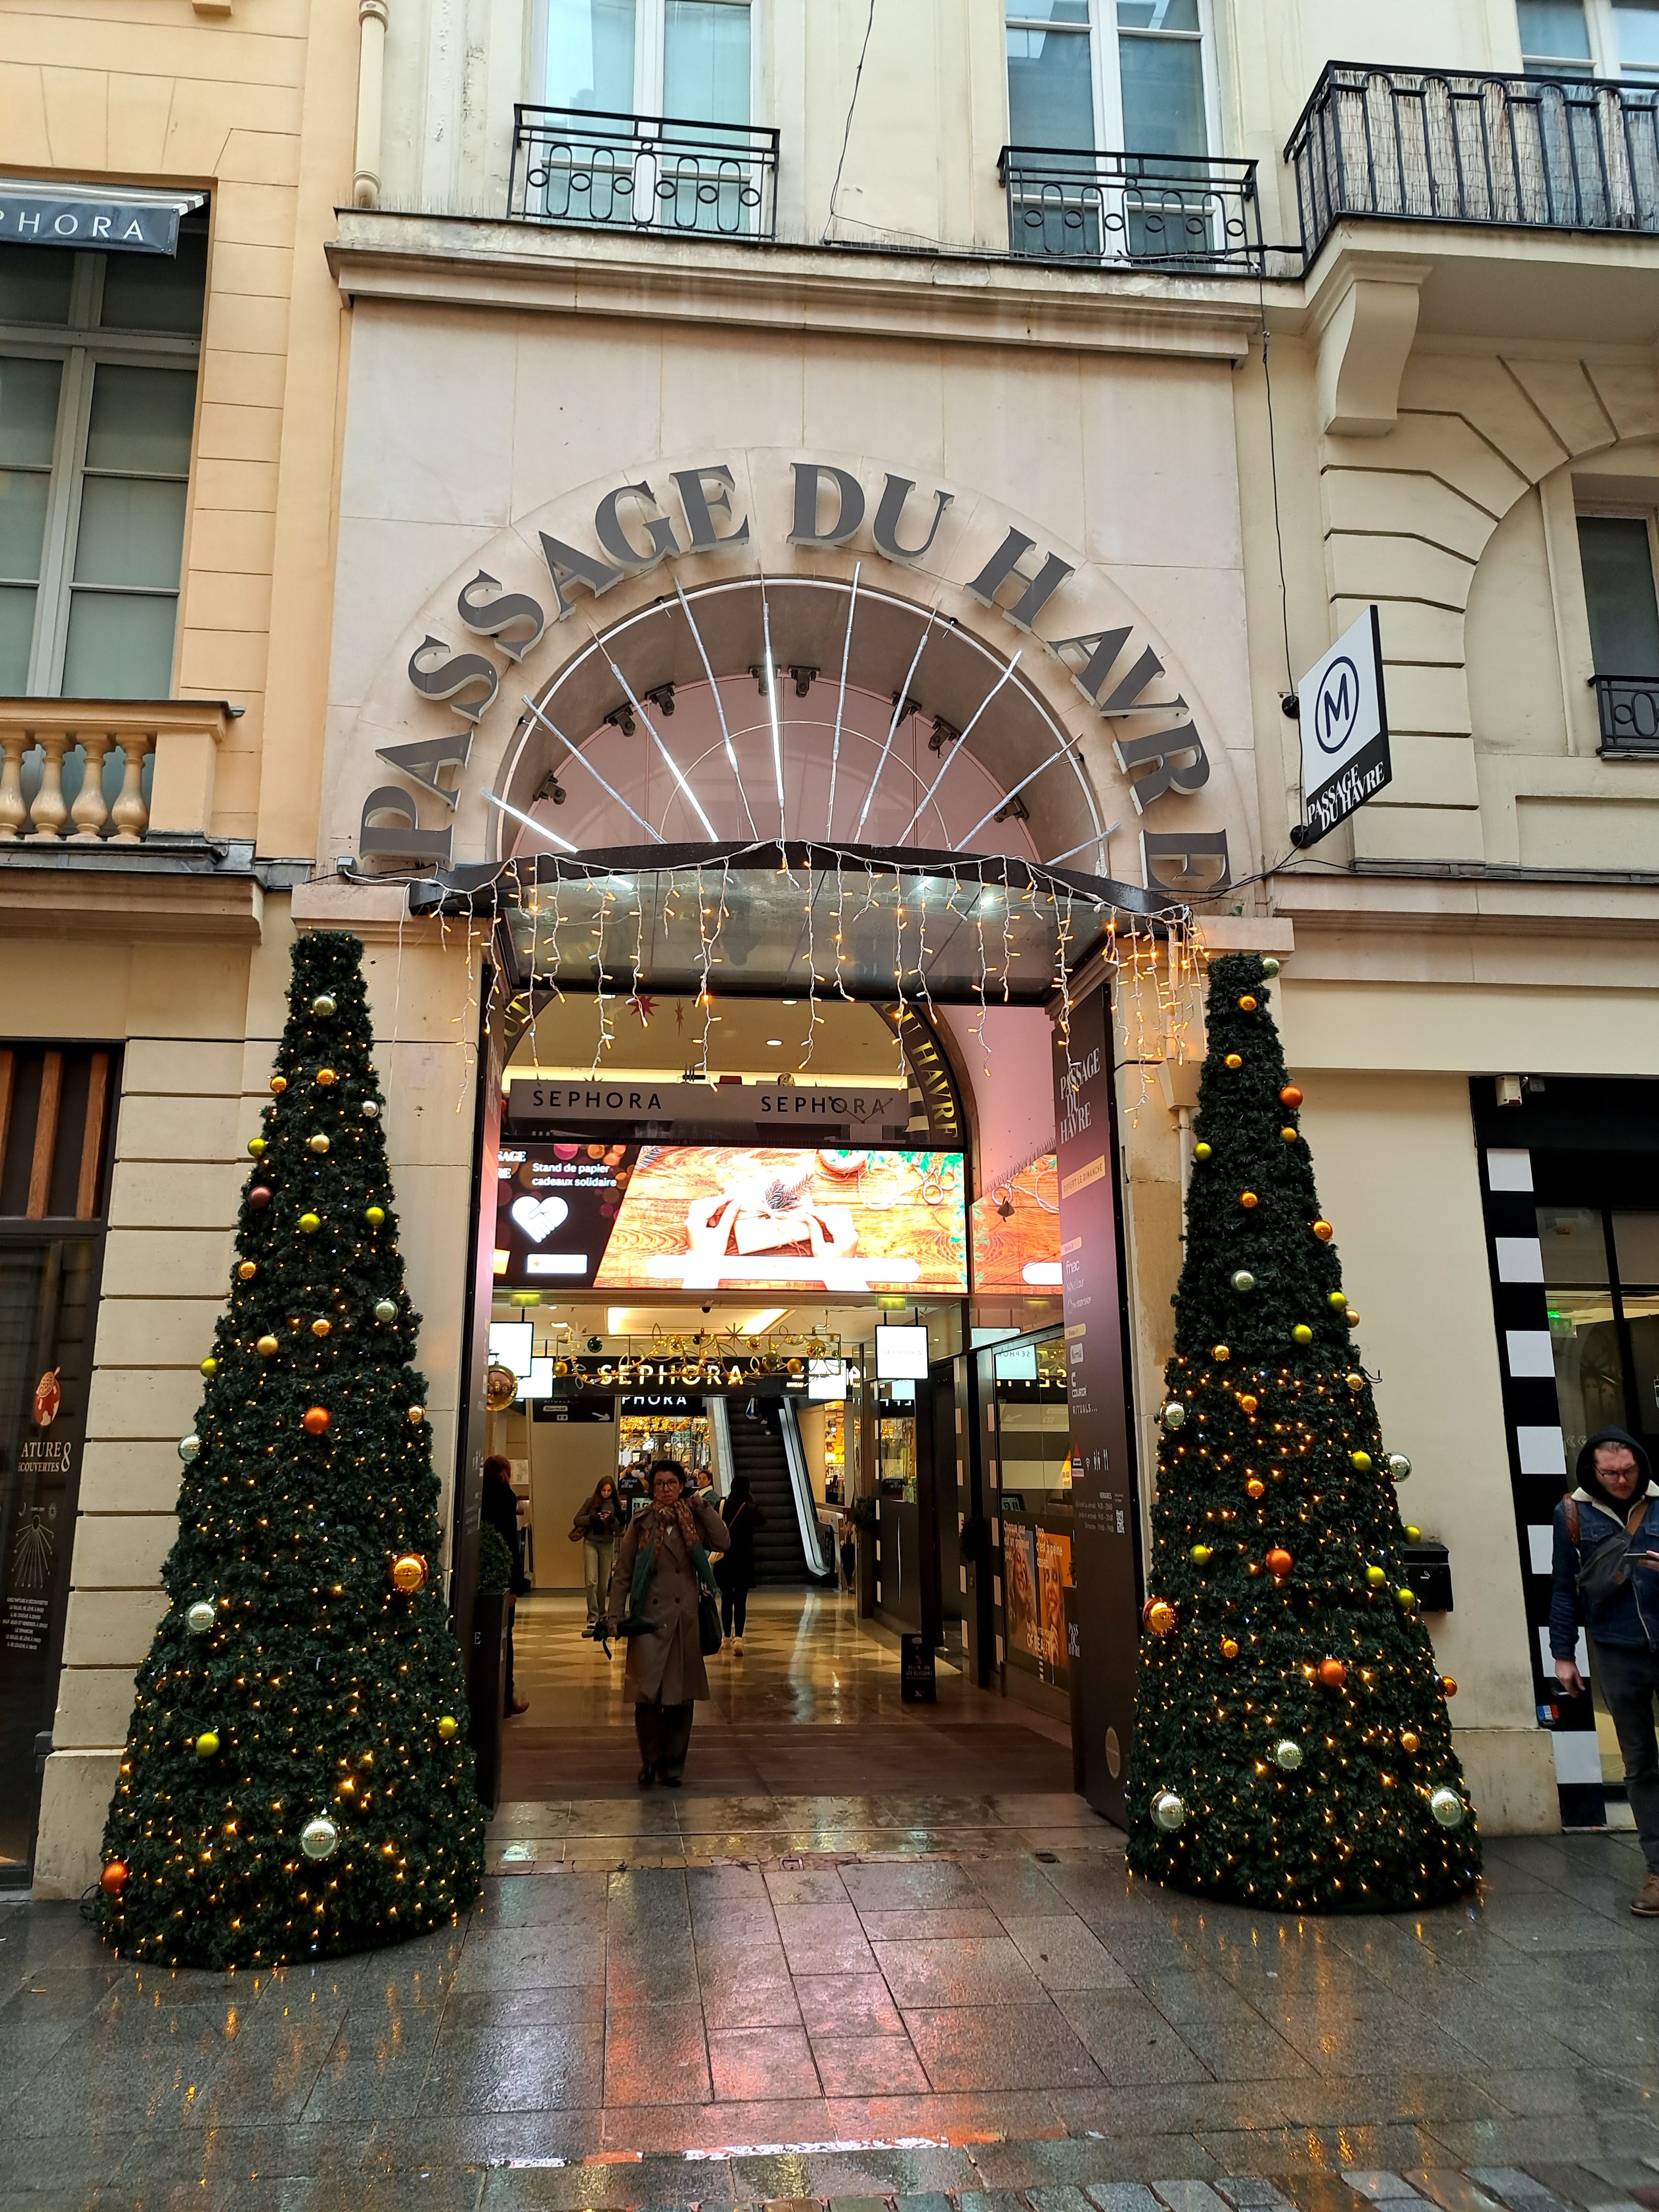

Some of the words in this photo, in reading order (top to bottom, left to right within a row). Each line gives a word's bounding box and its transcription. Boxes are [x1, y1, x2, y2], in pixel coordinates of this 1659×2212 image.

[360, 464, 750, 872] PASSAGE
[786, 462, 955, 564] DU
[962, 525, 1232, 891] HAVRE
[1324, 672, 1350, 739] M
[1307, 763, 1360, 826] PASSAGE
[1321, 798, 1339, 831] DU
[1341, 761, 1385, 814] HAVRE
[911, 1039, 959, 1138] HAVRE
[1060, 1047, 1100, 1101] PASSAGE
[532, 1090, 662, 1110] SEPHORA
[761, 1095, 885, 1115] SEPHORA
[1060, 1101, 1092, 1145] HAVRE
[531, 1176, 573, 1186] cadeaux
[574, 1177, 617, 1187] solidaire
[532, 1162, 562, 1173] Stand
[564, 1163, 577, 1173] de
[578, 1163, 610, 1175] papier
[1066, 1260, 1080, 1275] fnac
[600, 1364, 744, 1385] SEPHORA
